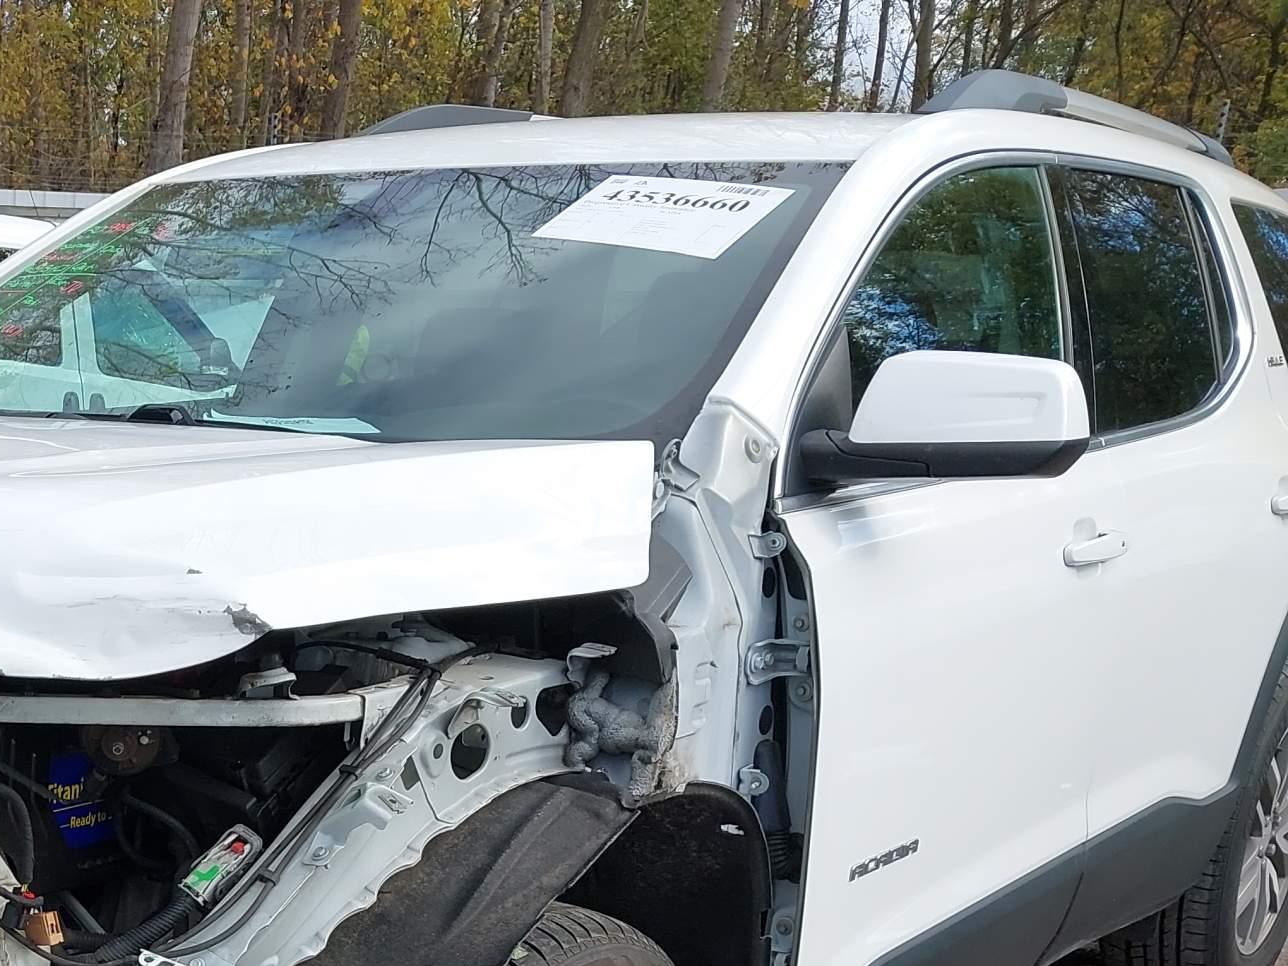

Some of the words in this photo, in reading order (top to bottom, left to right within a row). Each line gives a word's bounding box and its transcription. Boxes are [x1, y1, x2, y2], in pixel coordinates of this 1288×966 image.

[601, 189, 751, 213] 43536660
[70, 811, 96, 829] Ready
[97, 811, 107, 823] to
[848, 838, 920, 882] ACADIA
